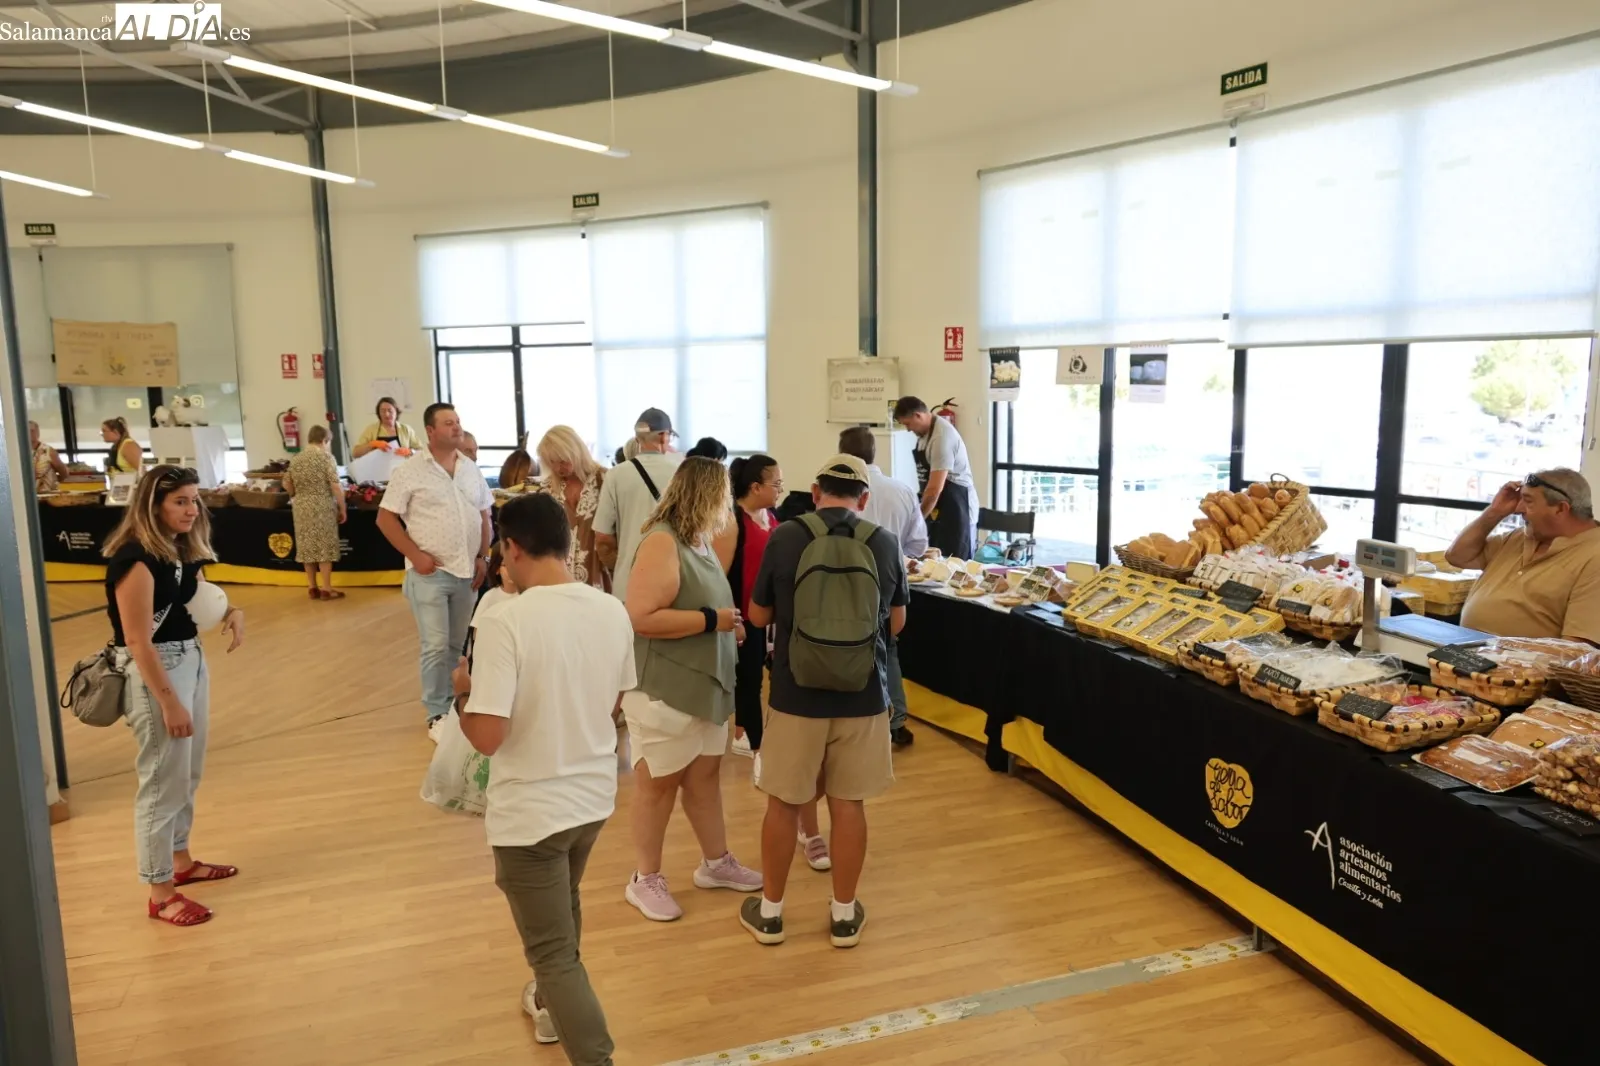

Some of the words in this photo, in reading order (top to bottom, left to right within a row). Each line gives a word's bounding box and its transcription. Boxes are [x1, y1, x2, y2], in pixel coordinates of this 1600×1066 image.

[1225, 69, 1262, 90] SALIDA
[575, 196, 597, 206] SALIDA
[1340, 836, 1393, 872] asociación
[1340, 848, 1388, 882] artesanos
[1338, 877, 1361, 896] Castilla
[1361, 892, 1367, 901] y
[1367, 894, 1384, 909] León
[1340, 861, 1402, 903] alimentarios
